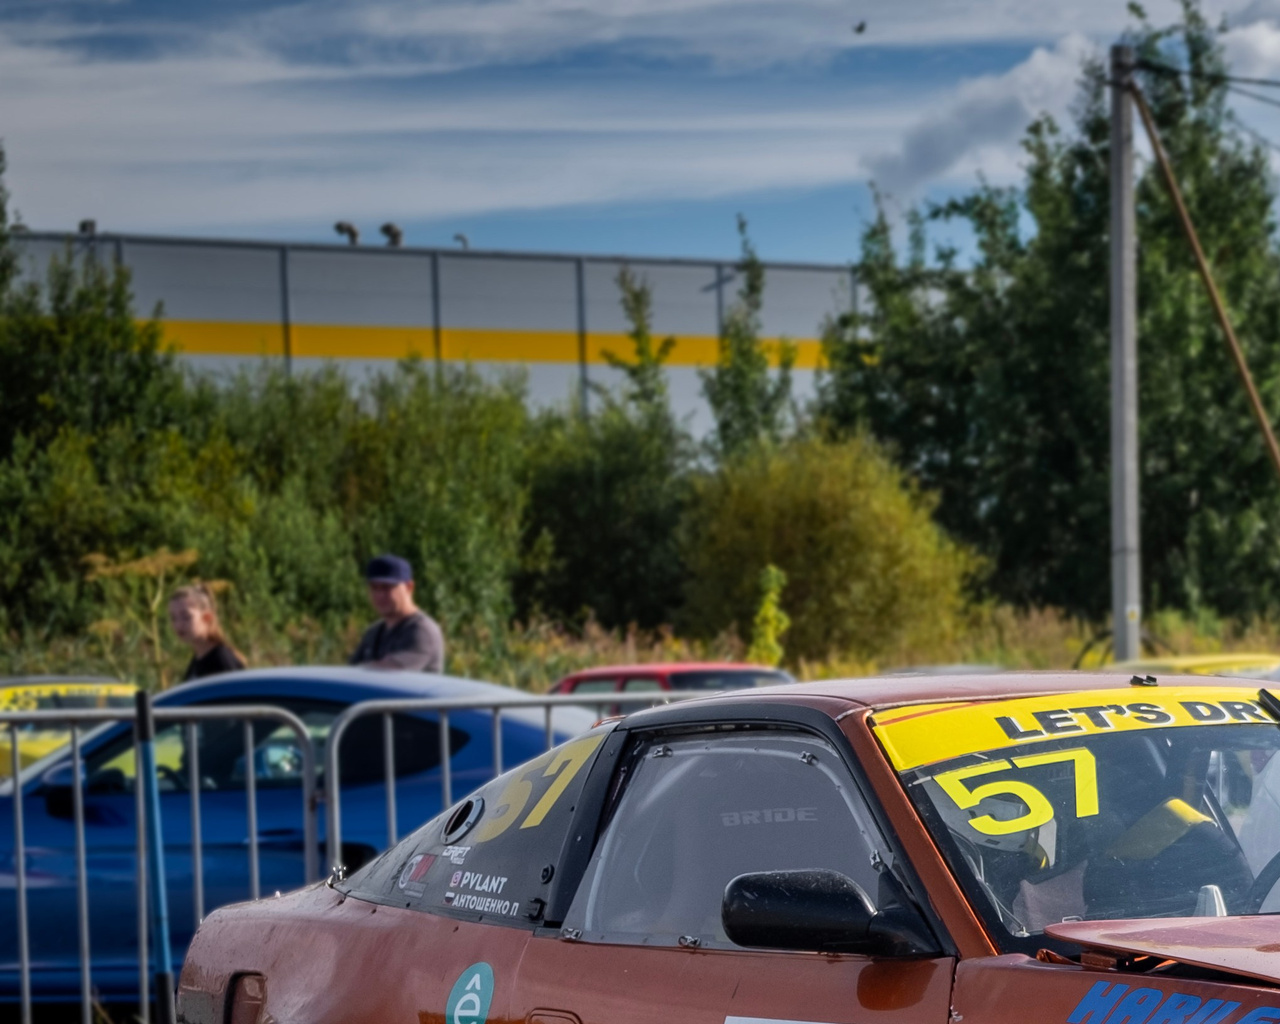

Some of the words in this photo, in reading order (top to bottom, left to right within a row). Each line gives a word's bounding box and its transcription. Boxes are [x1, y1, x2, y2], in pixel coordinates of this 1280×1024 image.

[995, 701, 1174, 741] LET'S
[475, 733, 606, 844] 57
[931, 747, 1100, 836] 57
[719, 806, 818, 828] BRIDE
[460, 871, 508, 894] PVLANT
[451, 893, 509, 915] АНТОШЕНКО
